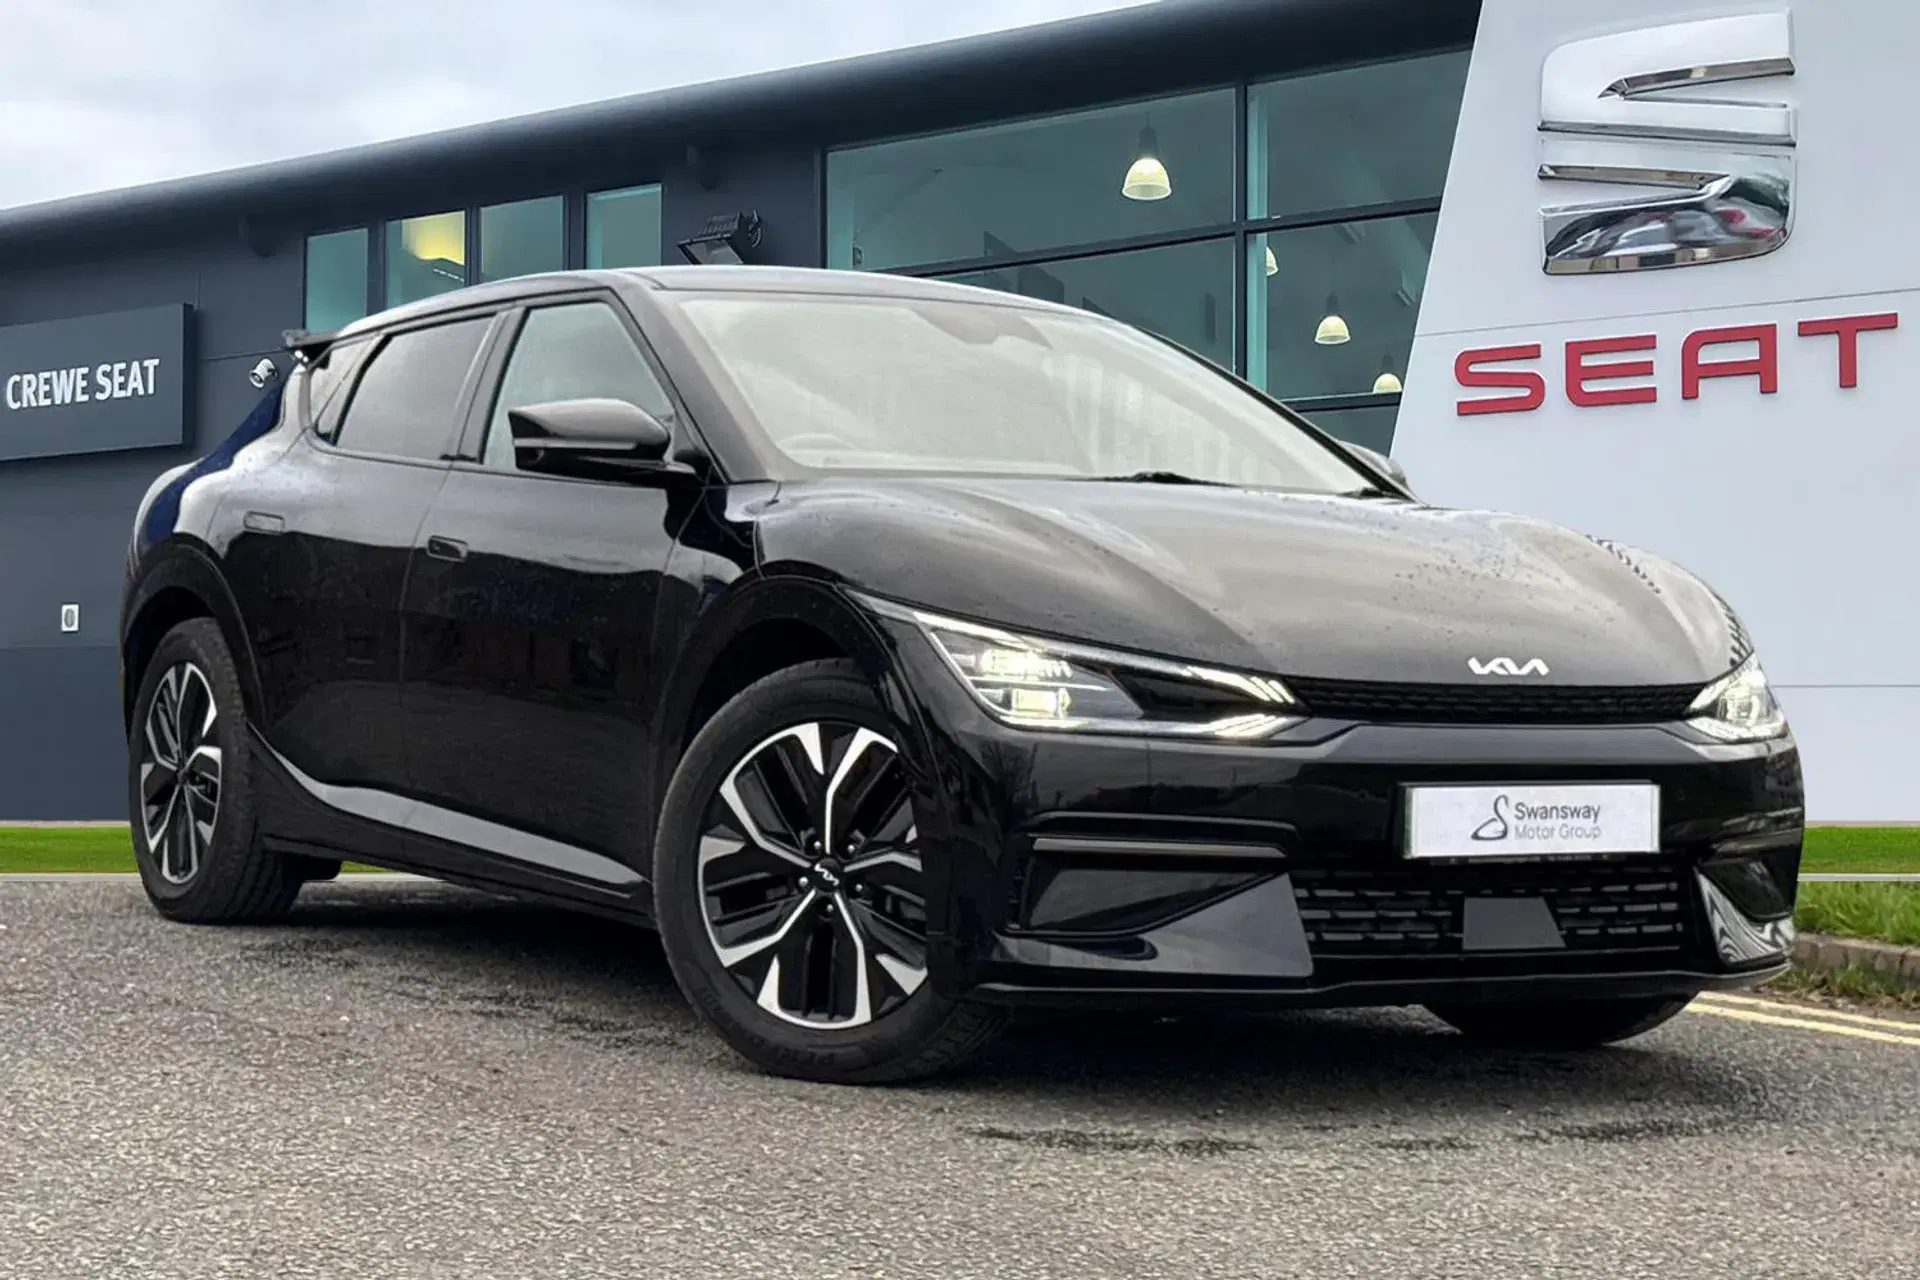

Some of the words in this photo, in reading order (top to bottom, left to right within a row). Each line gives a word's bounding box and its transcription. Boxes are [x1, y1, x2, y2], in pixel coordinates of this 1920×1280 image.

[1454, 311, 1898, 416] SEAT
[6, 366, 90, 410] CREWE
[95, 358, 160, 401] SEAT
[1514, 802, 1601, 823] Swansway
[1514, 824, 1555, 840] Motor
[1559, 822, 1602, 840] Group
